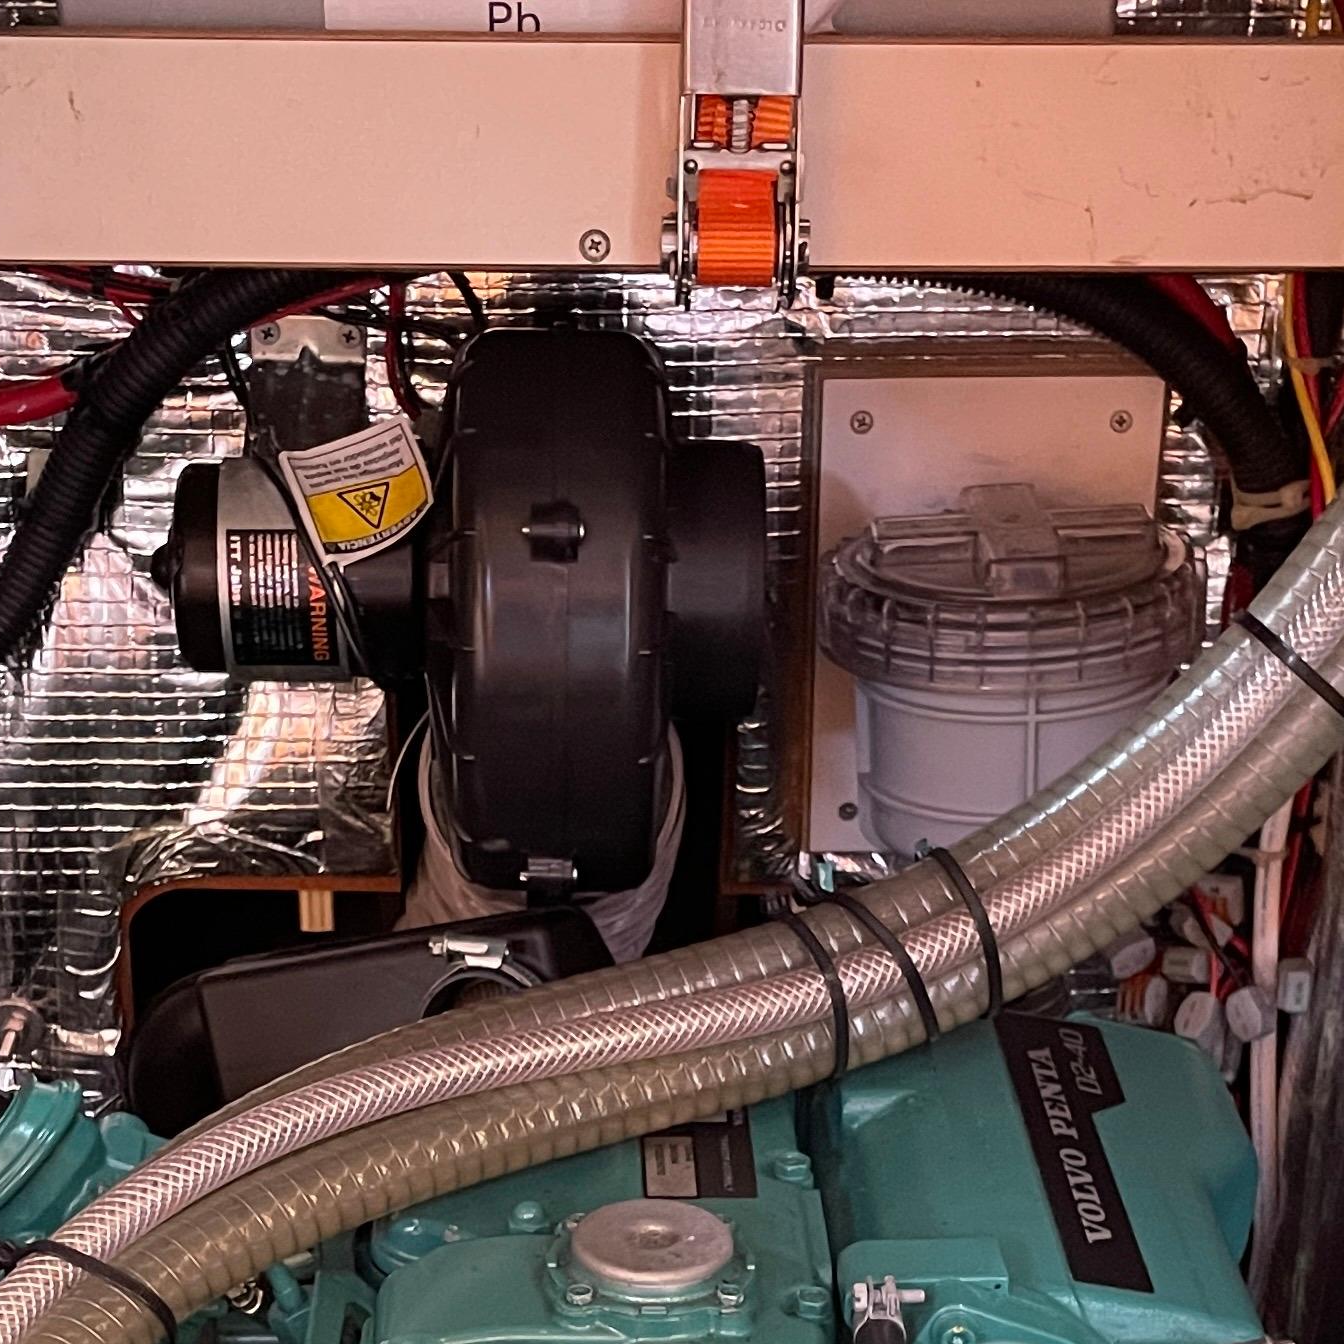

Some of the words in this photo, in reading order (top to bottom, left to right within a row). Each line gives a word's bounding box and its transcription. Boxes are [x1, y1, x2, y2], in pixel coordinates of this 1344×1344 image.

[1027, 1046, 1079, 1140] PENTA
[1058, 1028, 1104, 1096] D2-40
[1059, 1147, 1113, 1244] VOLVO
